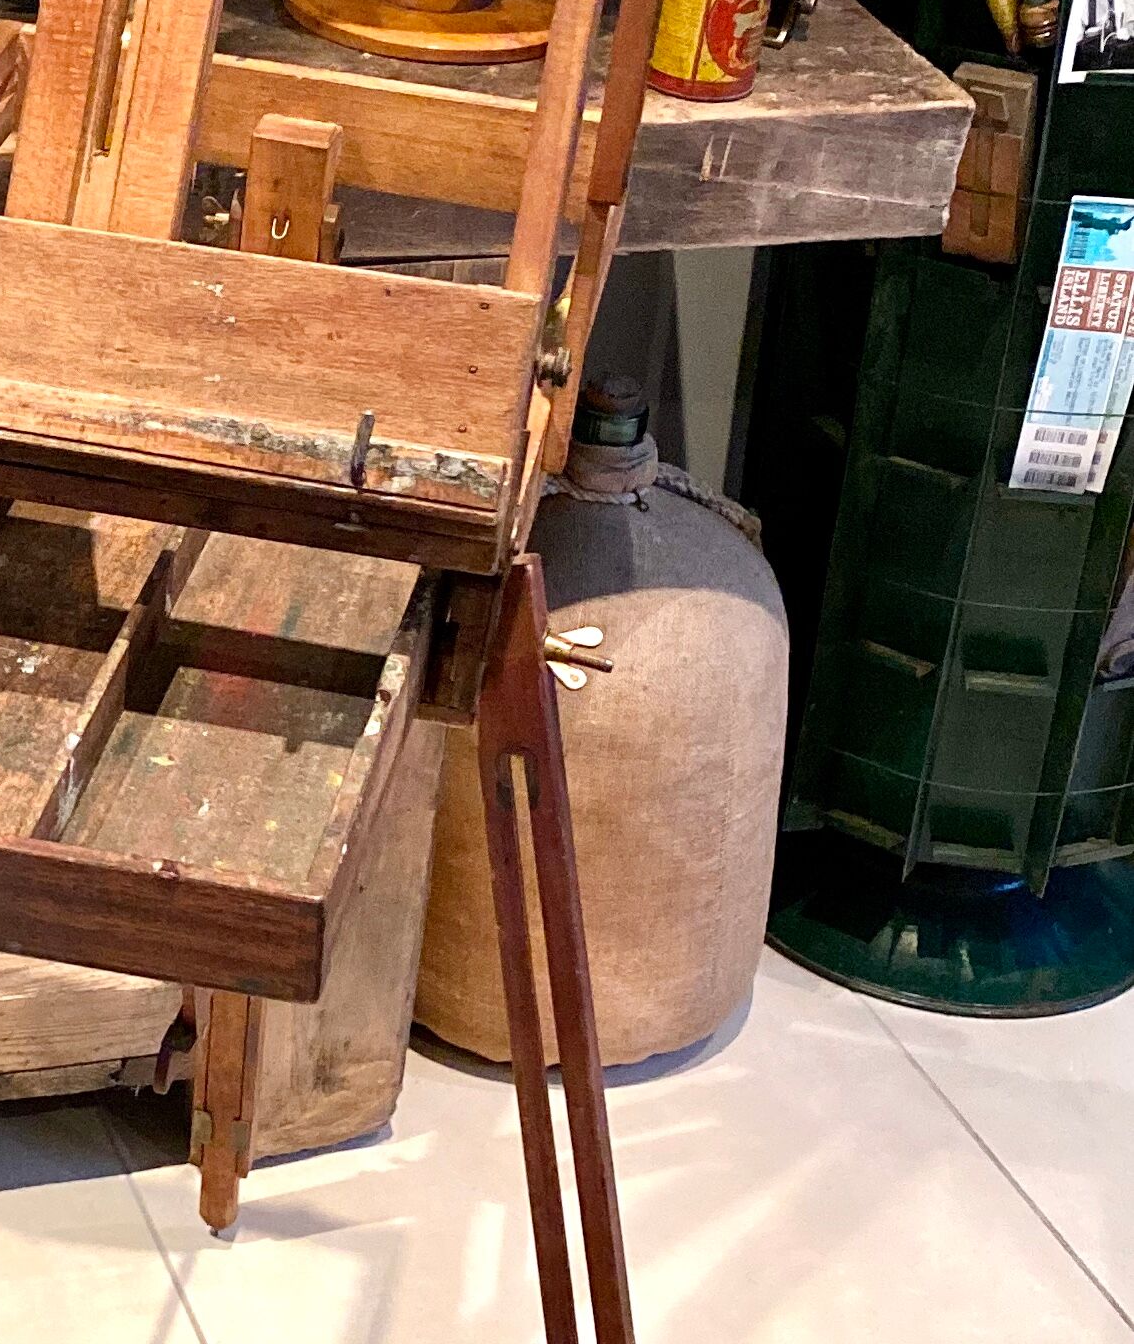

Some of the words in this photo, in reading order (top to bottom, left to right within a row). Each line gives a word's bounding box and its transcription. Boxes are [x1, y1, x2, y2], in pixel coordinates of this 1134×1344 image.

[1054, 269, 1076, 325] ISLAND
[1066, 270, 1090, 326] ELLIS
[1091, 272, 1111, 327] LIBERTY
[1106, 273, 1127, 329] STATUE
